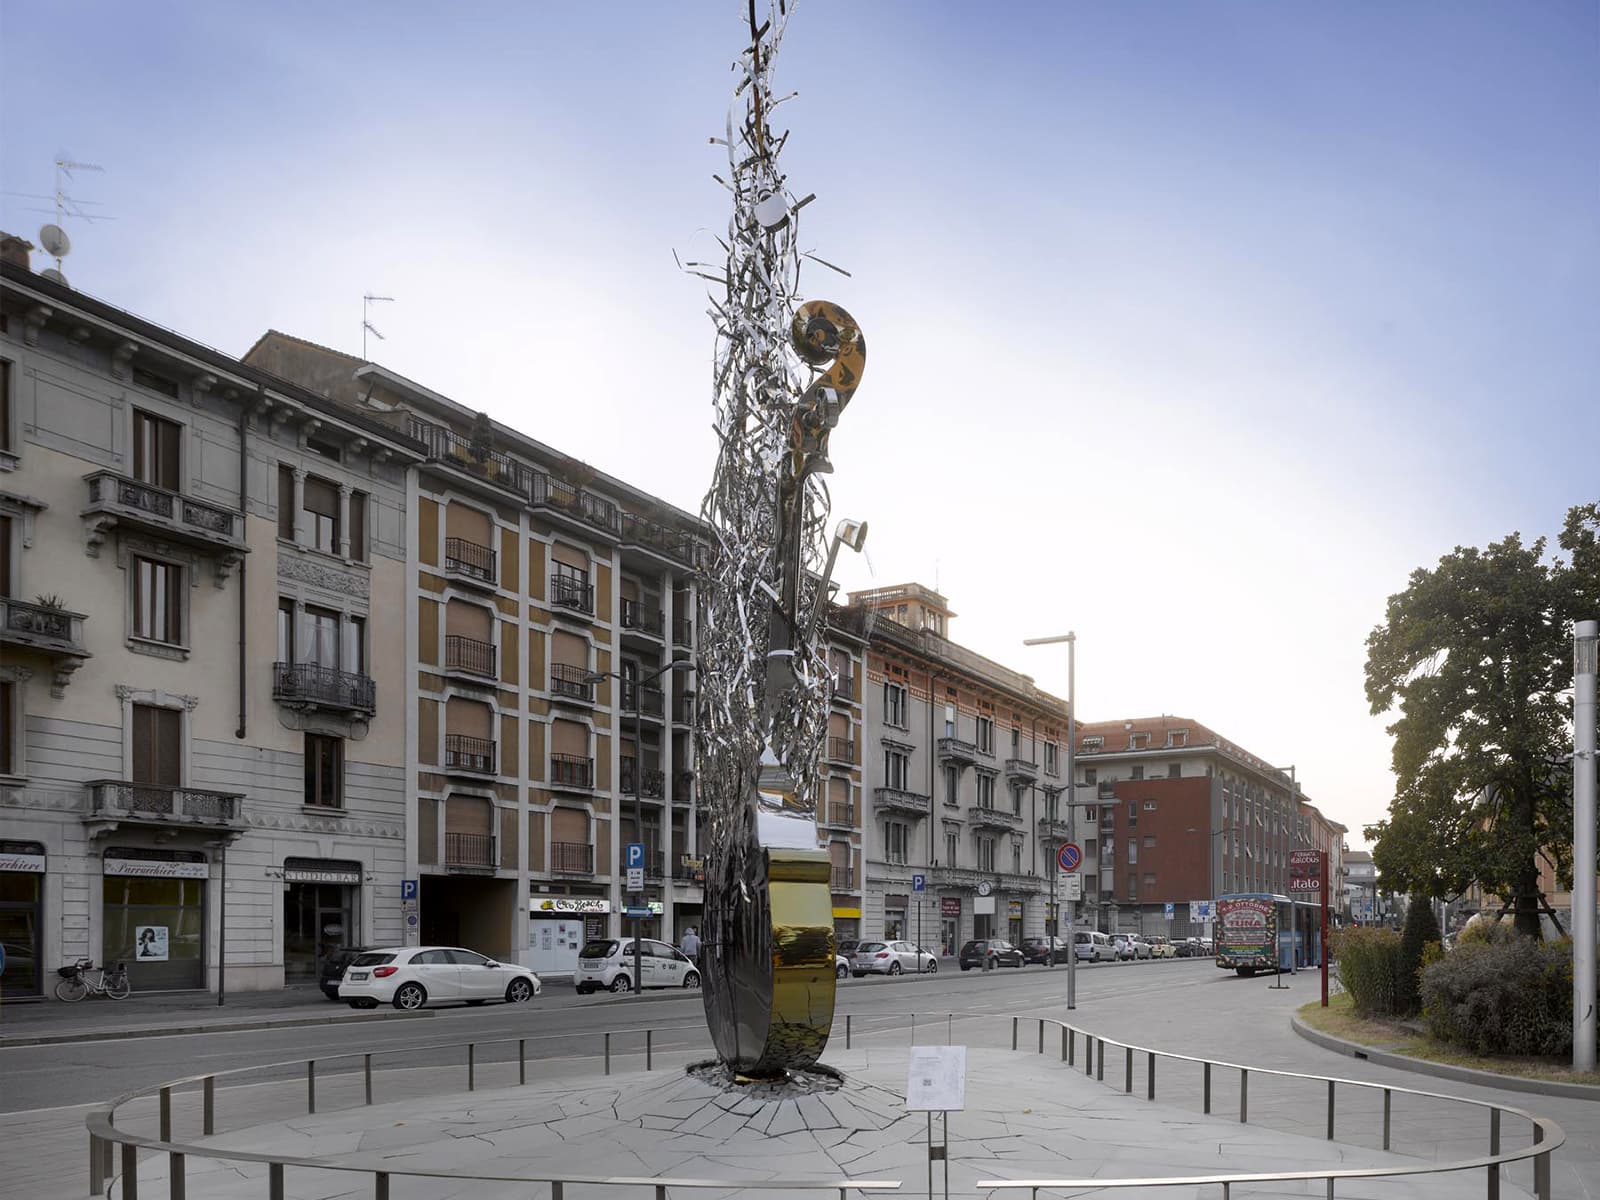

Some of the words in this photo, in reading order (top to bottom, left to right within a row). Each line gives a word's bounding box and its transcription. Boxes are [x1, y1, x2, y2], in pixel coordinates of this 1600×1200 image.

[629, 846, 642, 866] P
[404, 882, 415, 897] P
[914, 878, 923, 890] P
[1165, 903, 1174, 913] P
